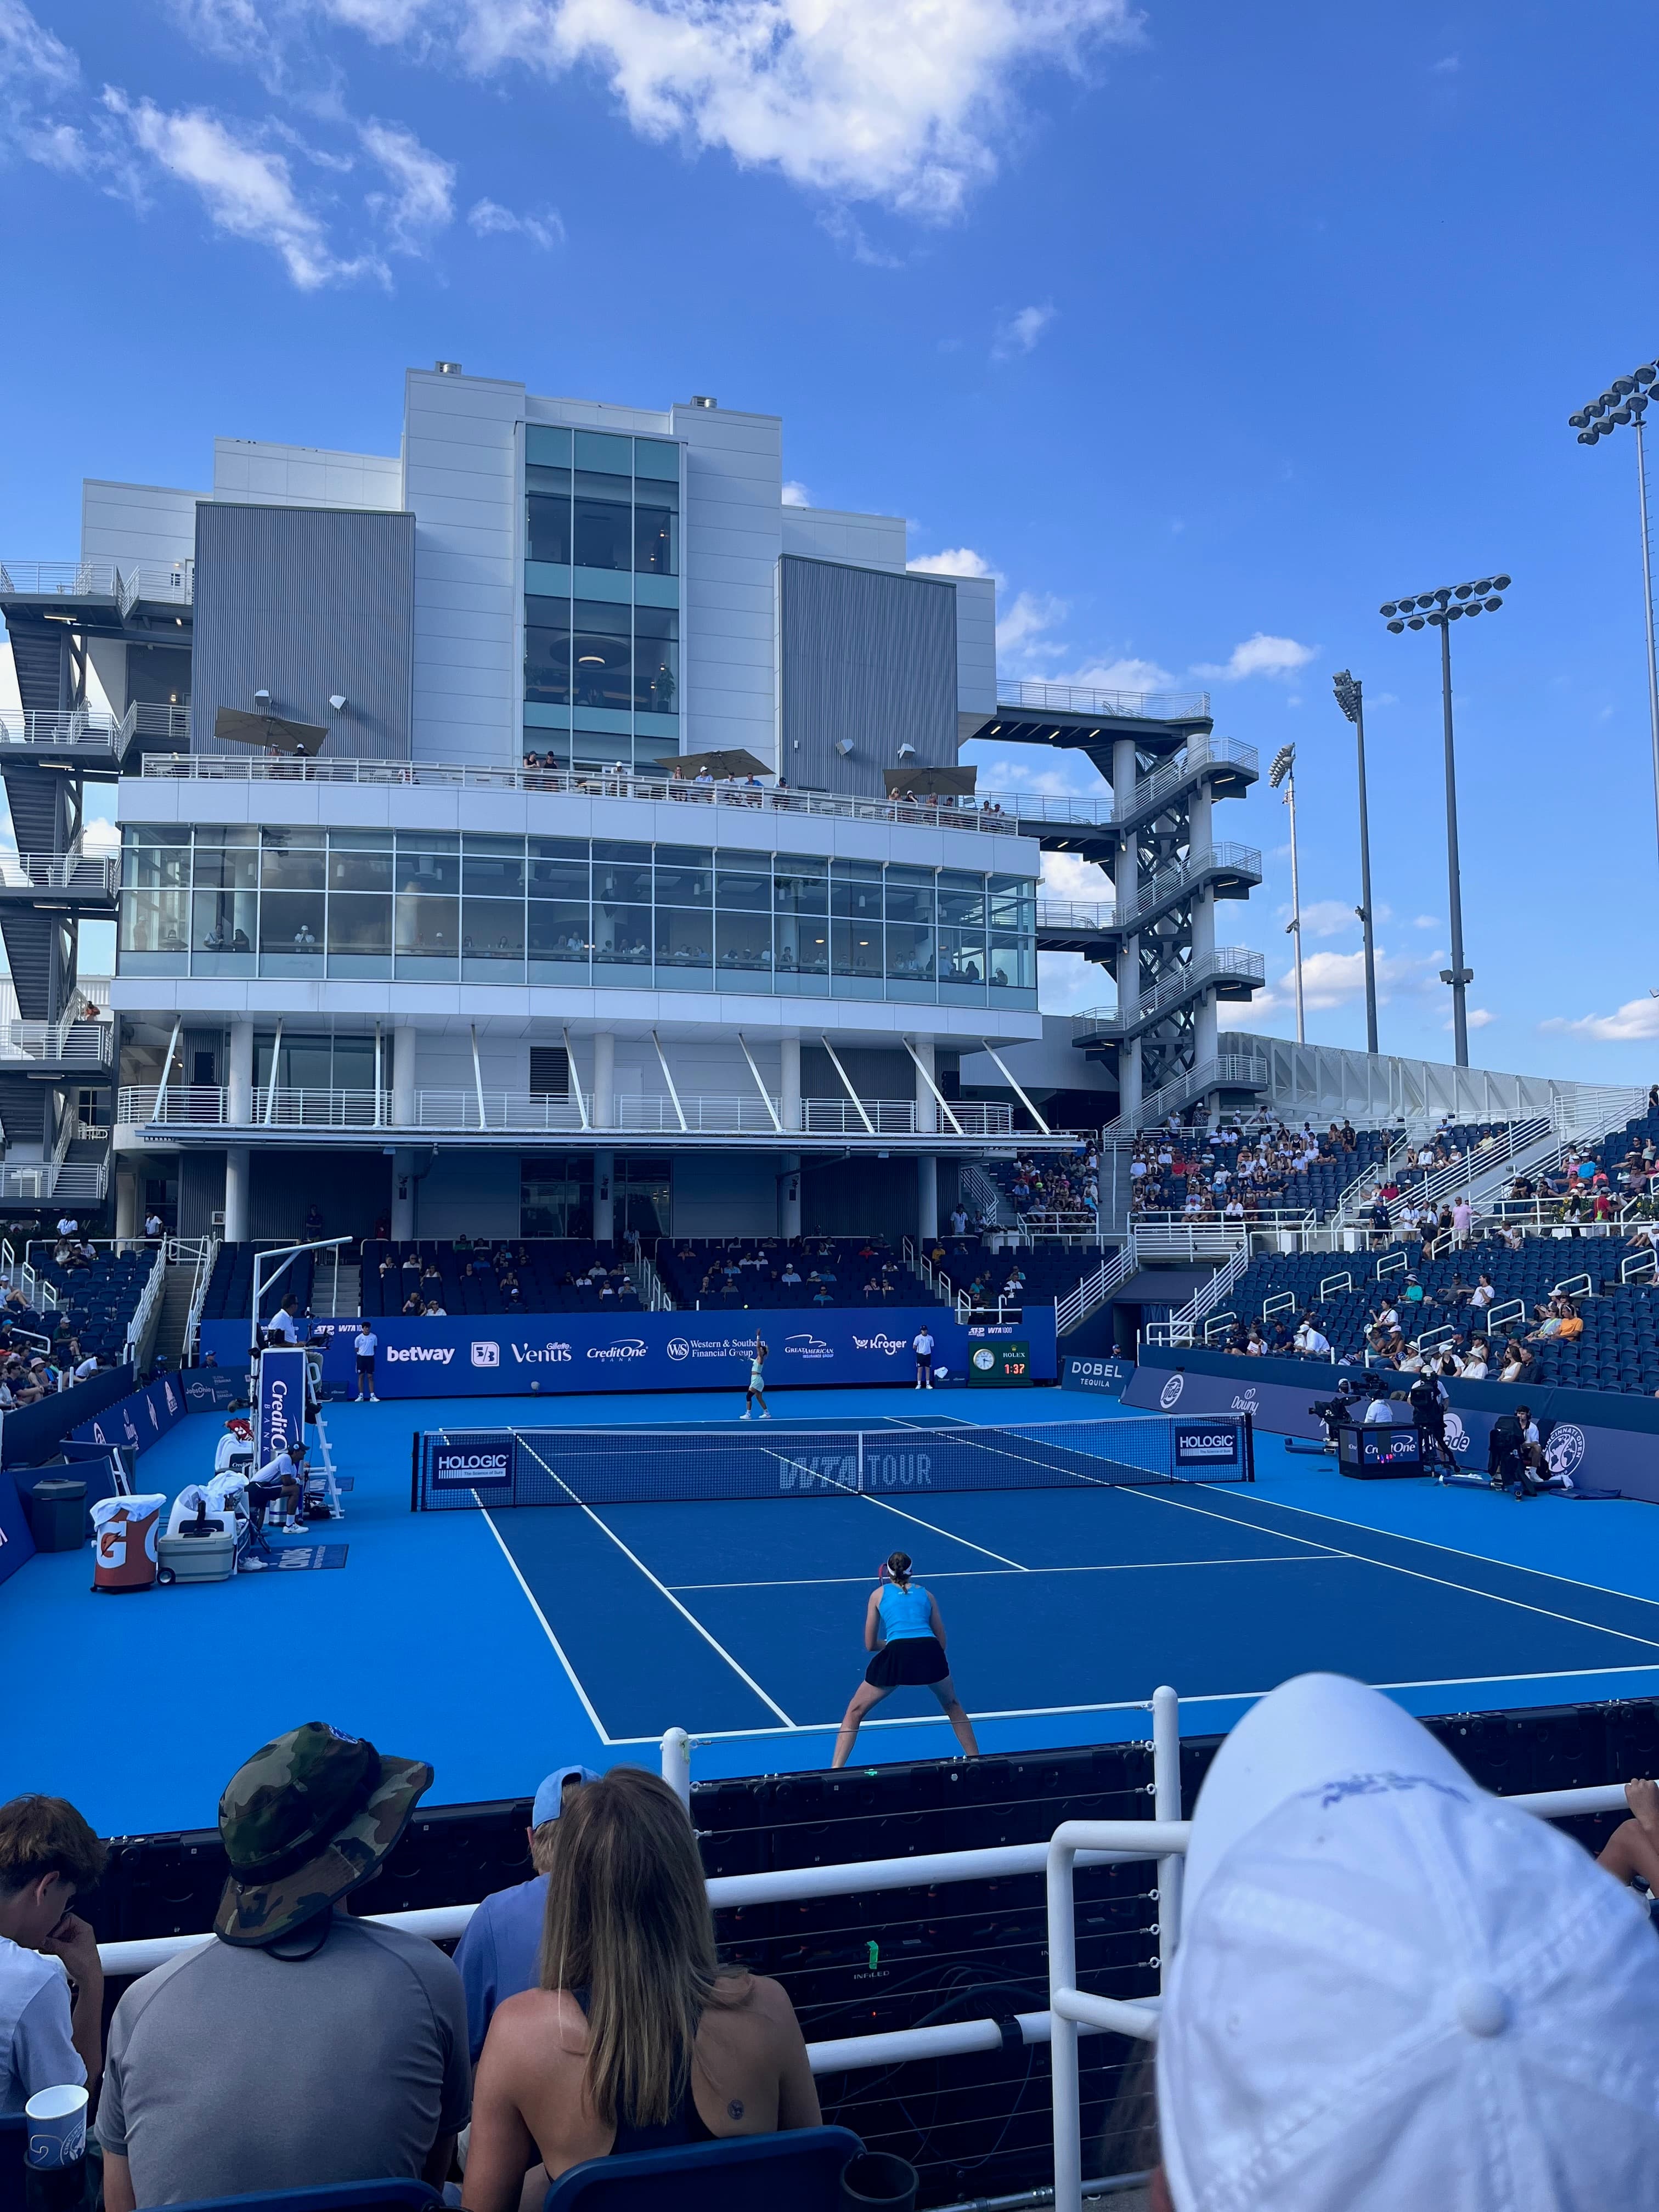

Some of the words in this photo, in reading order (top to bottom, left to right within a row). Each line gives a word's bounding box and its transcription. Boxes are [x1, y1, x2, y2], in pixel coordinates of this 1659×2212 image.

[870, 1333, 906, 1356] Kroger
[387, 1346, 455, 1364] betway
[511, 1344, 572, 1363] Venus
[692, 1349, 726, 1357] Financial
[1005, 1364, 1025, 1374] 1:37
[1071, 1362, 1122, 1378] DOBEL
[186, 1386, 211, 1394] JobsOhio
[1080, 1378, 1110, 1387] TEQUILA
[1231, 1396, 1259, 1415] Downy
[1180, 1435, 1233, 1447] HOLOGIC
[439, 1454, 507, 1469] HOLOGIC
[780, 1456, 856, 1488] WTA
[867, 1454, 932, 1485] TOUR
[96, 1520, 127, 1569] G
